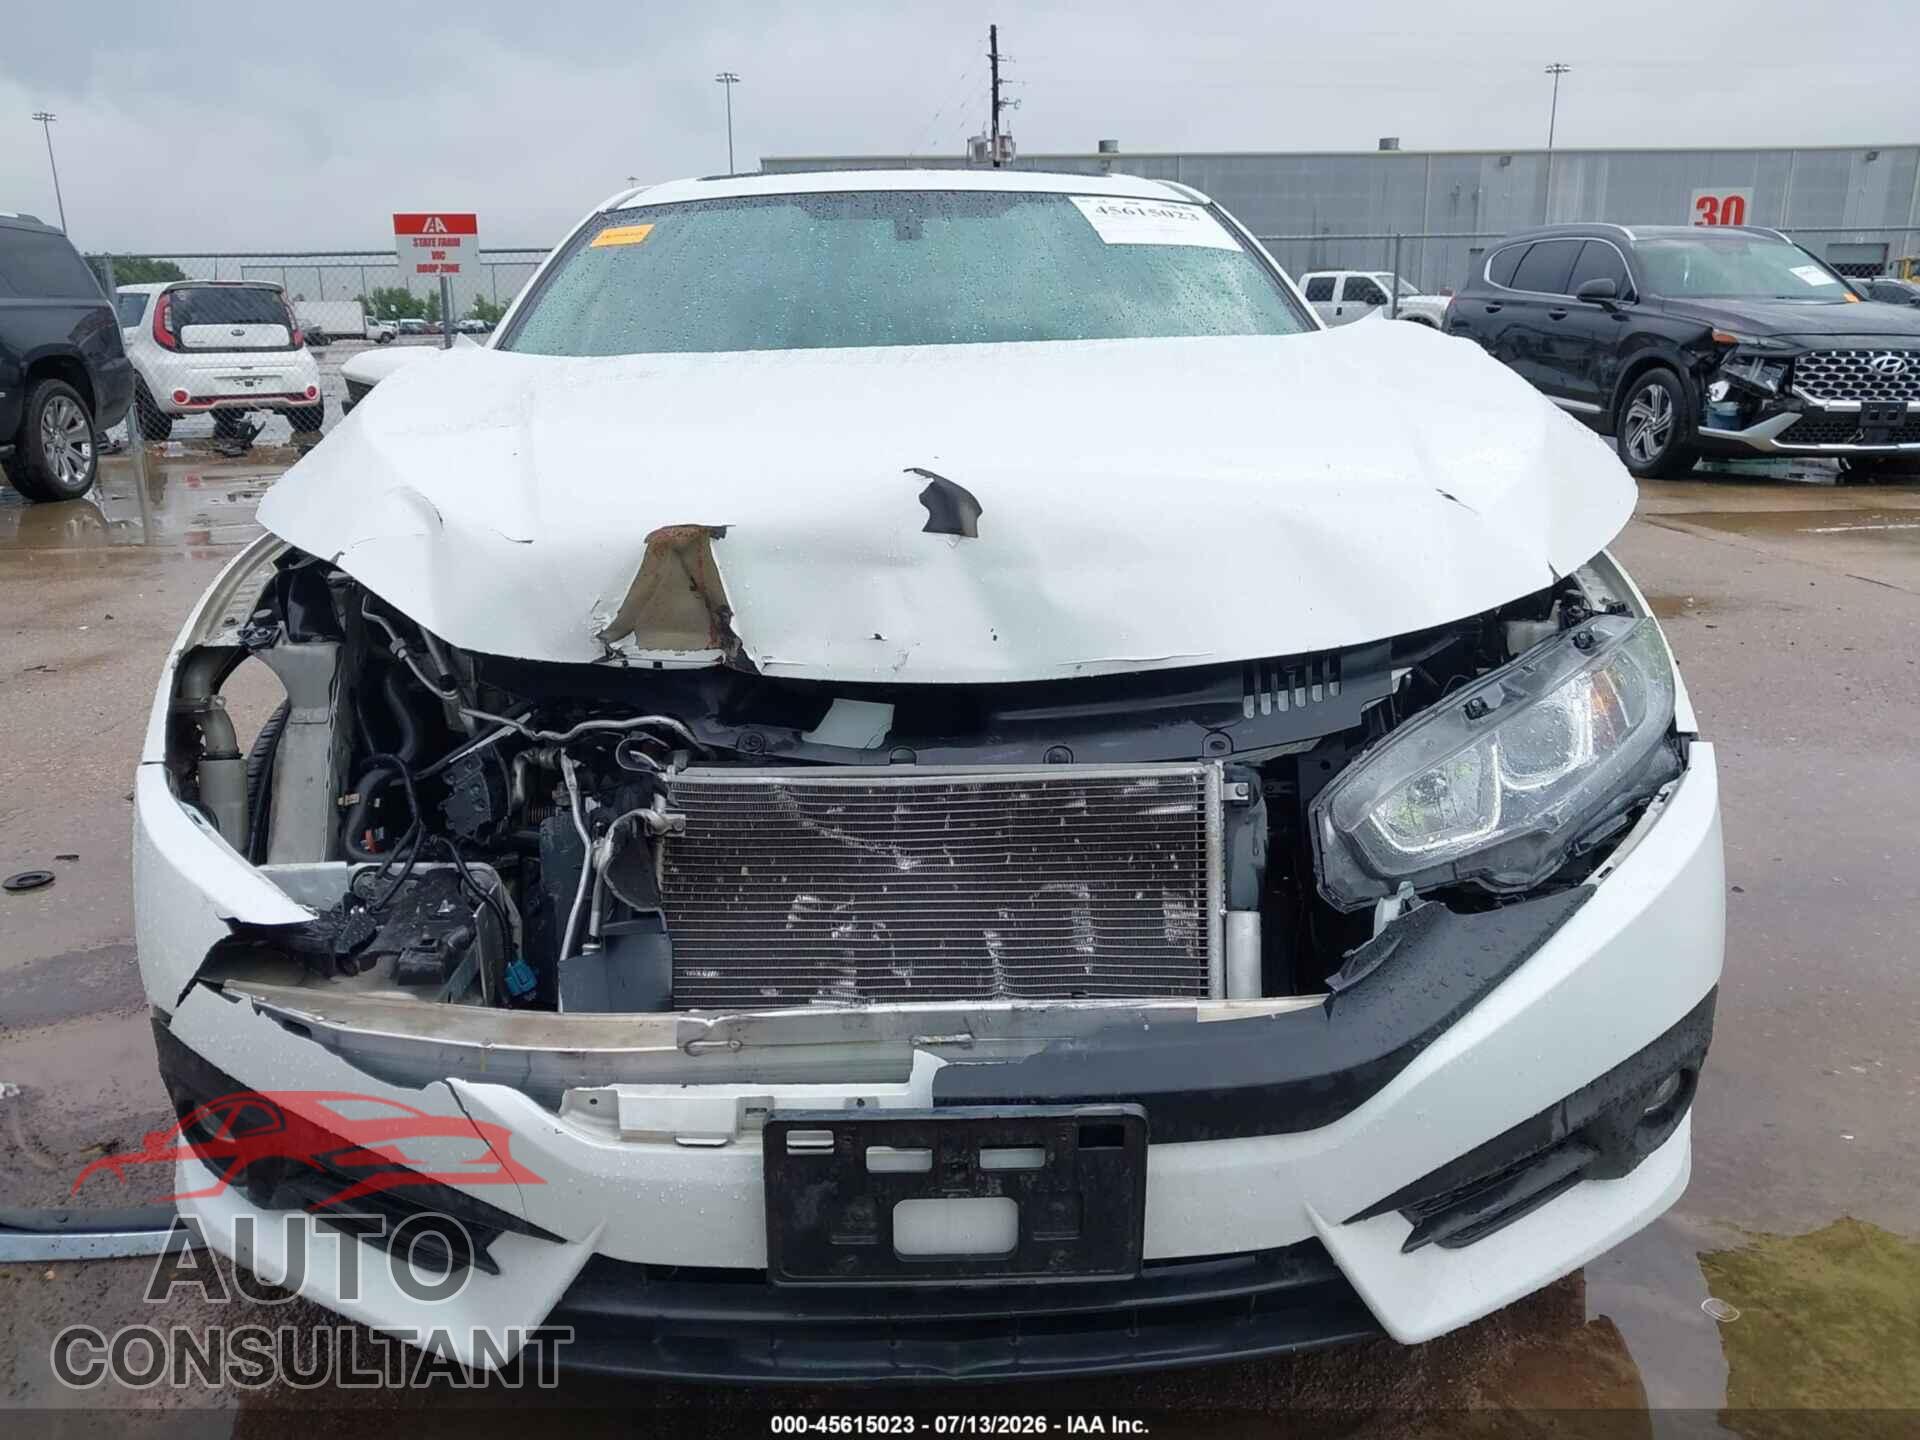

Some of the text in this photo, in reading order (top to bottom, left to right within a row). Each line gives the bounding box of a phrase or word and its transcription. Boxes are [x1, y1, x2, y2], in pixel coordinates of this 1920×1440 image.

[1096, 205, 1201, 222] 45615023
[1695, 196, 1745, 225] 30
[412, 237, 461, 248] STATE FARM
[431, 250, 446, 261] VIC
[416, 263, 461, 273] DROP ZONE
